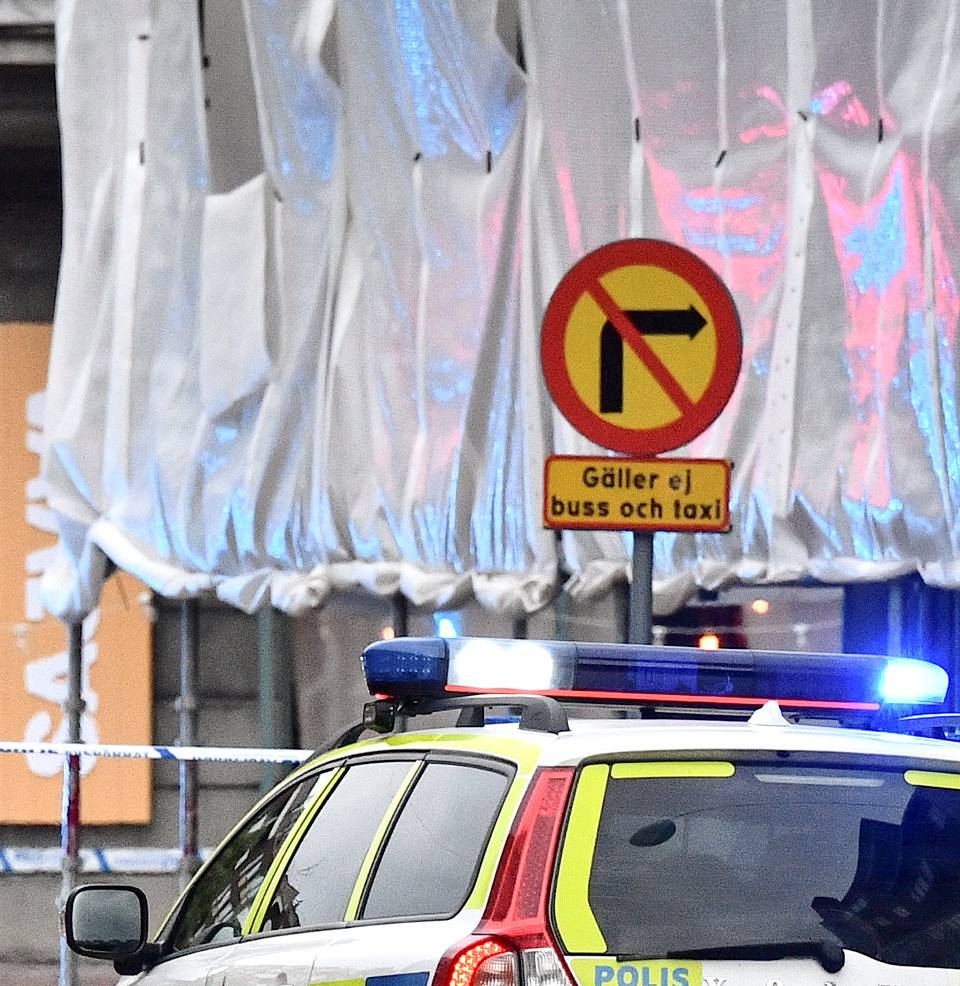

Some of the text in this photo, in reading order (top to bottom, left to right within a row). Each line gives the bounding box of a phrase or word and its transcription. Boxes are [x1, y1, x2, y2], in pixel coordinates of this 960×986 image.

[582, 466, 692, 495] Gäller ej
[551, 495, 722, 520] buss och taxi
